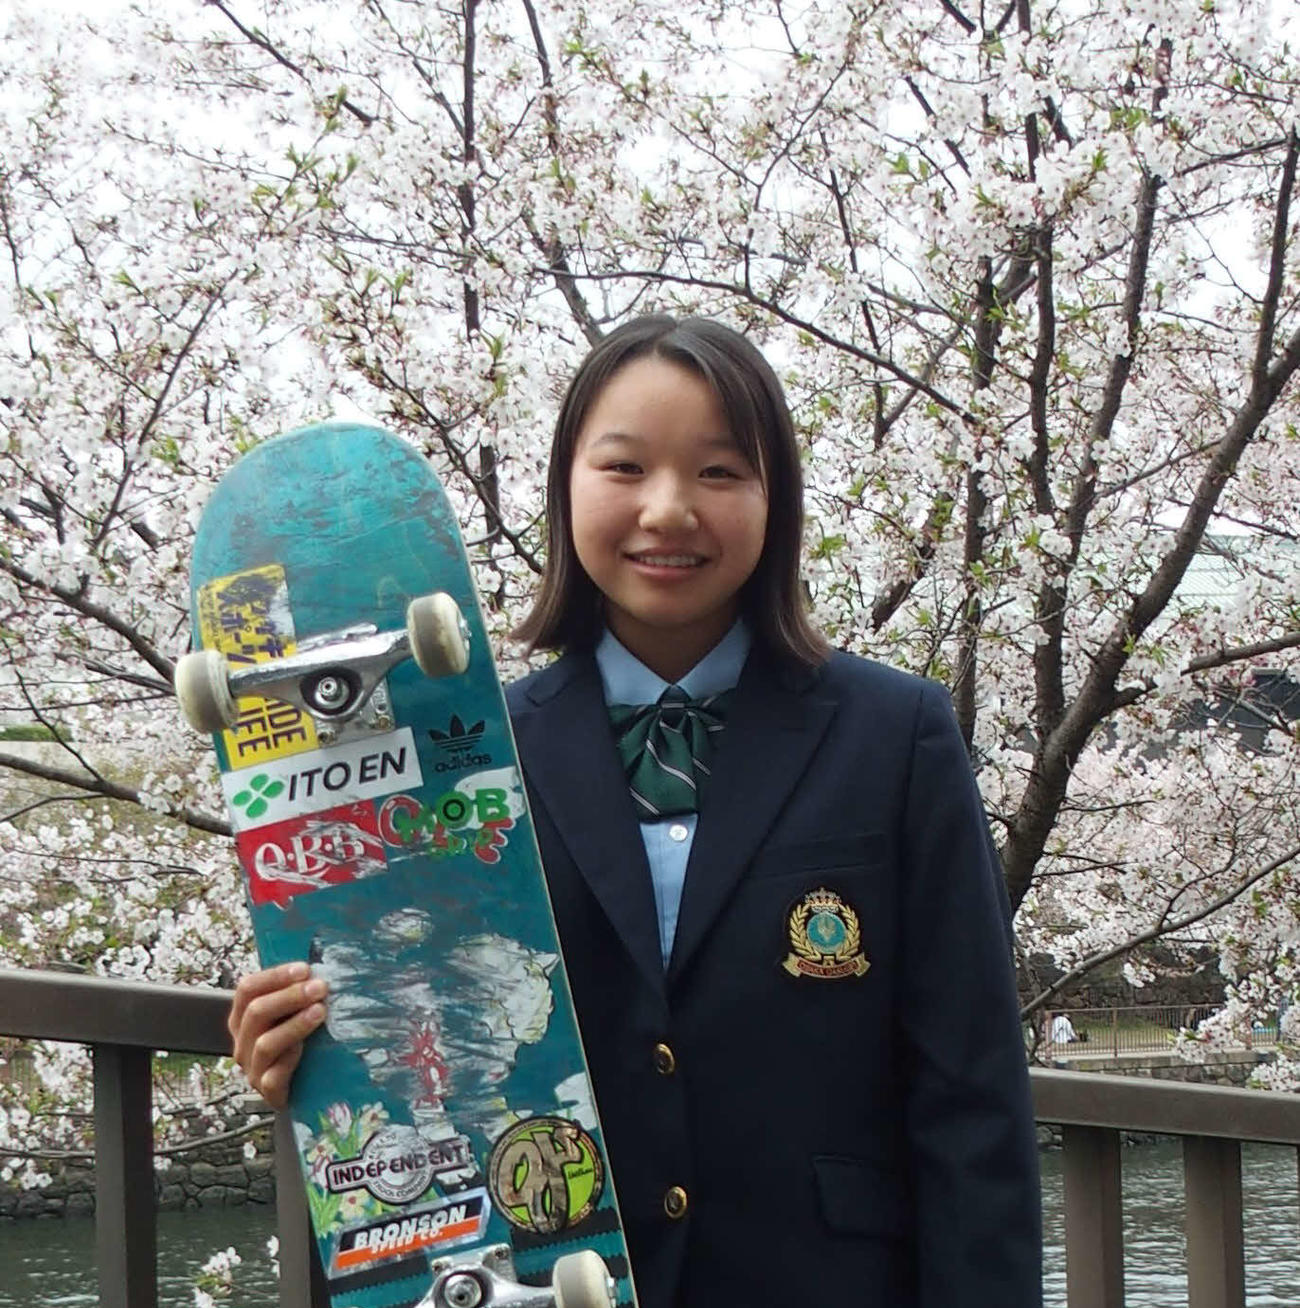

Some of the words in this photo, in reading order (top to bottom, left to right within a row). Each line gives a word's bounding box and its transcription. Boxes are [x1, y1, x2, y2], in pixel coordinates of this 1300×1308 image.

[236, 707, 271, 757] IFE
[264, 698, 307, 750] IDE
[288, 762, 351, 801] ITO
[358, 747, 407, 785] EN
[433, 752, 492, 773] adidas
[332, 1143, 467, 1186] INDEPENDENT
[354, 1204, 467, 1249] BRONSON
